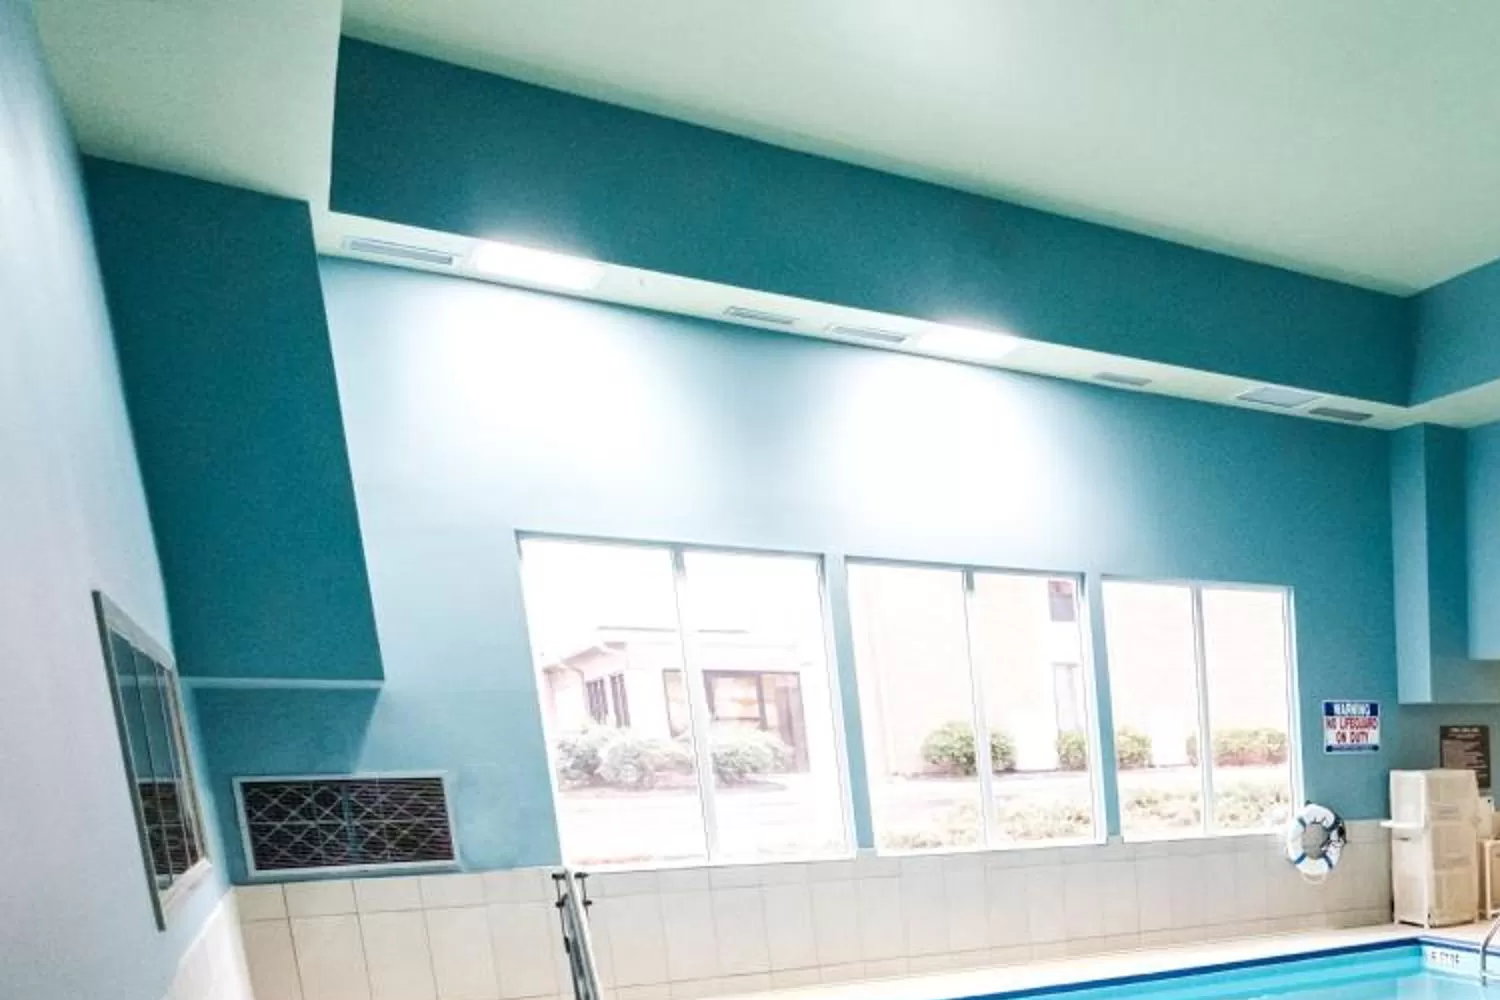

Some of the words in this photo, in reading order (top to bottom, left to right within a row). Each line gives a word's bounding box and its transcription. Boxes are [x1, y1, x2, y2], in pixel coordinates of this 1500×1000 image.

[1333, 703, 1371, 716] WARNING
[1326, 717, 1337, 729] NO
[1340, 717, 1377, 729] LIFEGUARD
[1336, 731, 1347, 743] ON
[1351, 731, 1369, 743] DUTY
